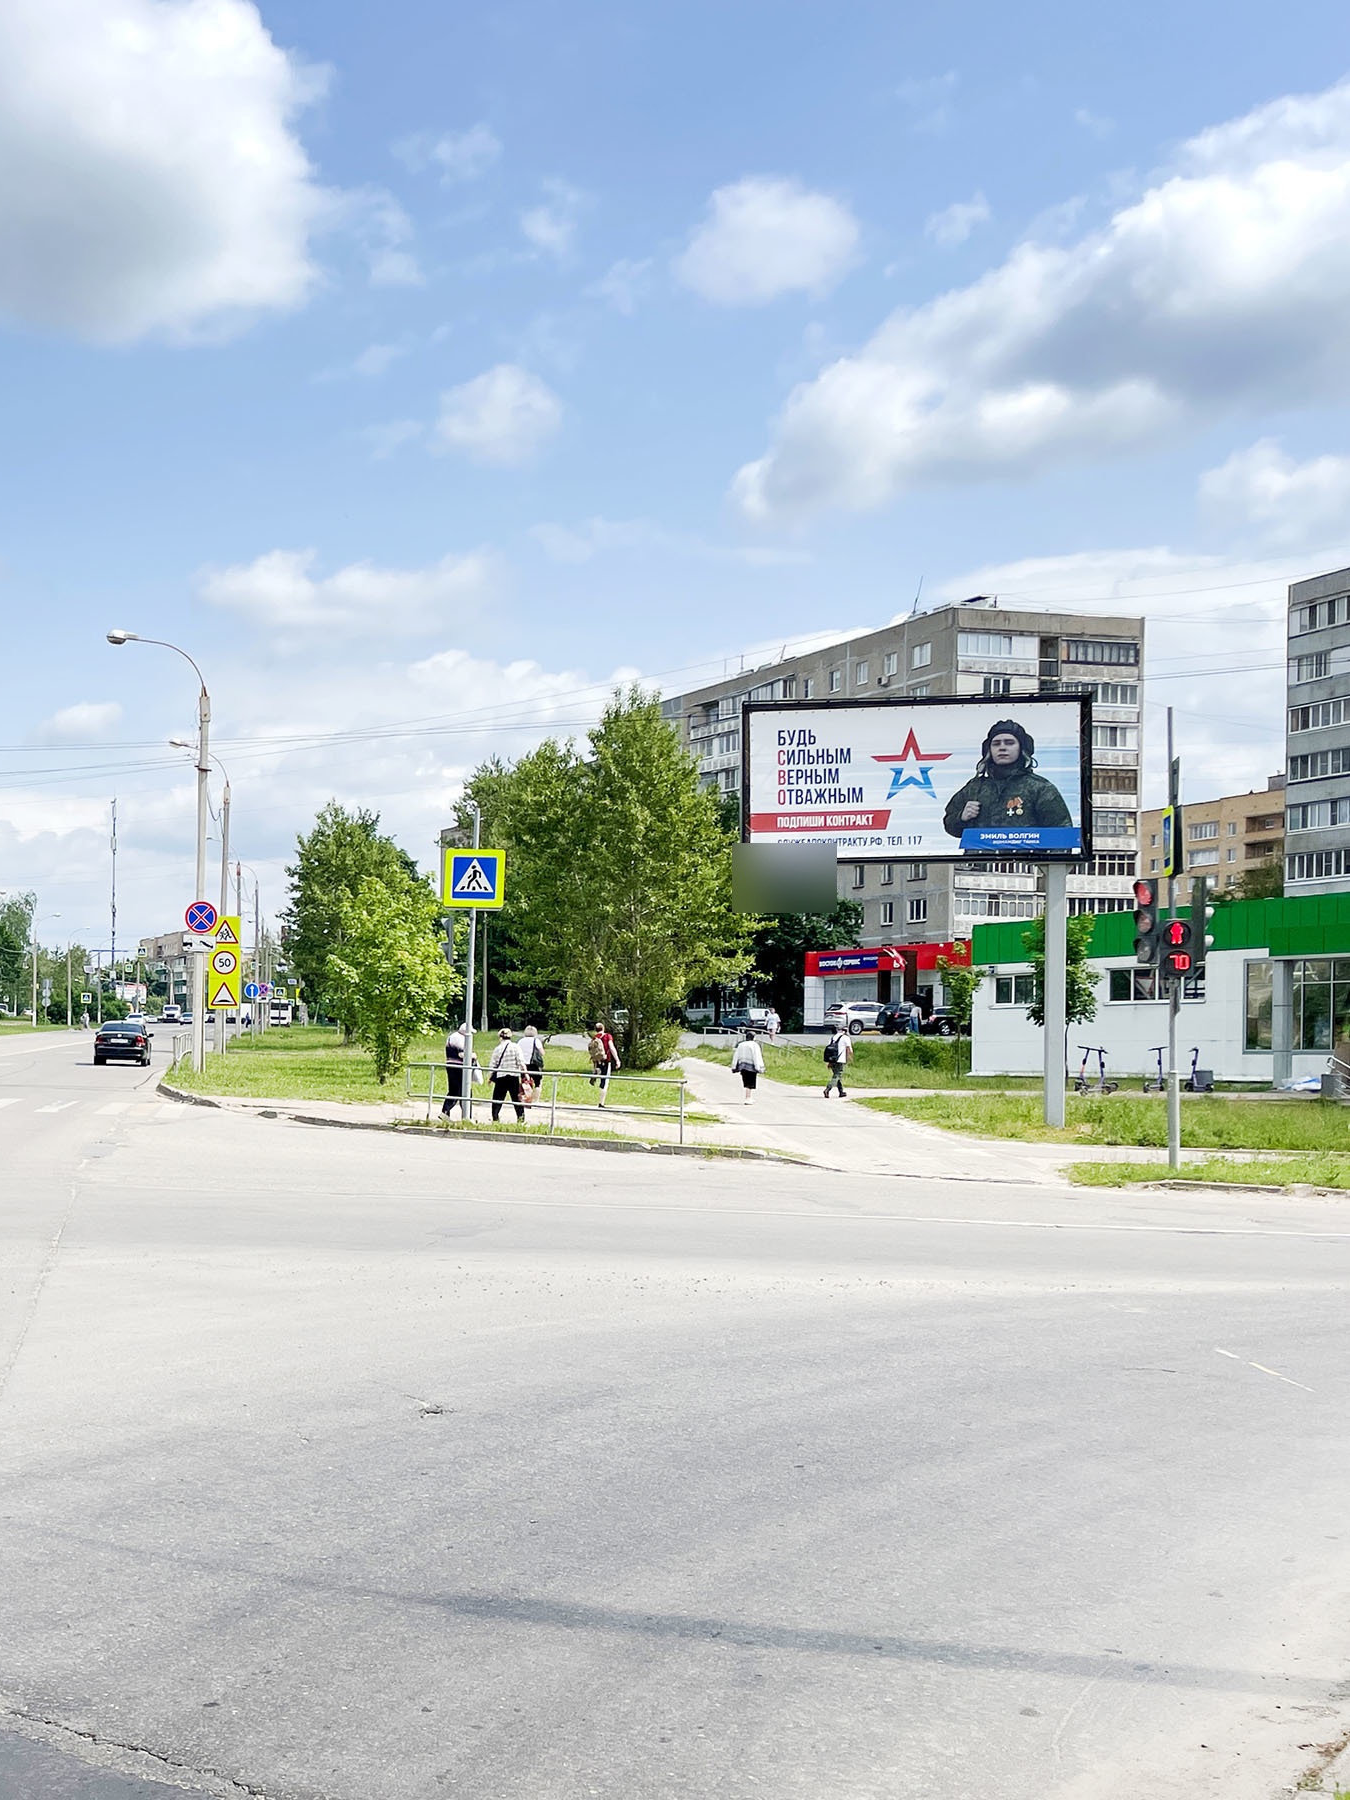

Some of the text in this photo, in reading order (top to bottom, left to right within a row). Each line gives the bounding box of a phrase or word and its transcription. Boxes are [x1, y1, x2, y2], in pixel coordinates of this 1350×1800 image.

[777, 729, 817, 748] БУДЬ
[777, 747, 852, 766] СИЛЬНЫМ
[777, 767, 840, 786] ВЕРНЫМ
[777, 786, 863, 805] ОТВАЖНЫМ
[776, 813, 875, 829] ПОДПИШИ КОНТРАКТ
[908, 835, 922, 846] 117
[218, 958, 232, 968] 50
[1169, 954, 1190, 971] 70
